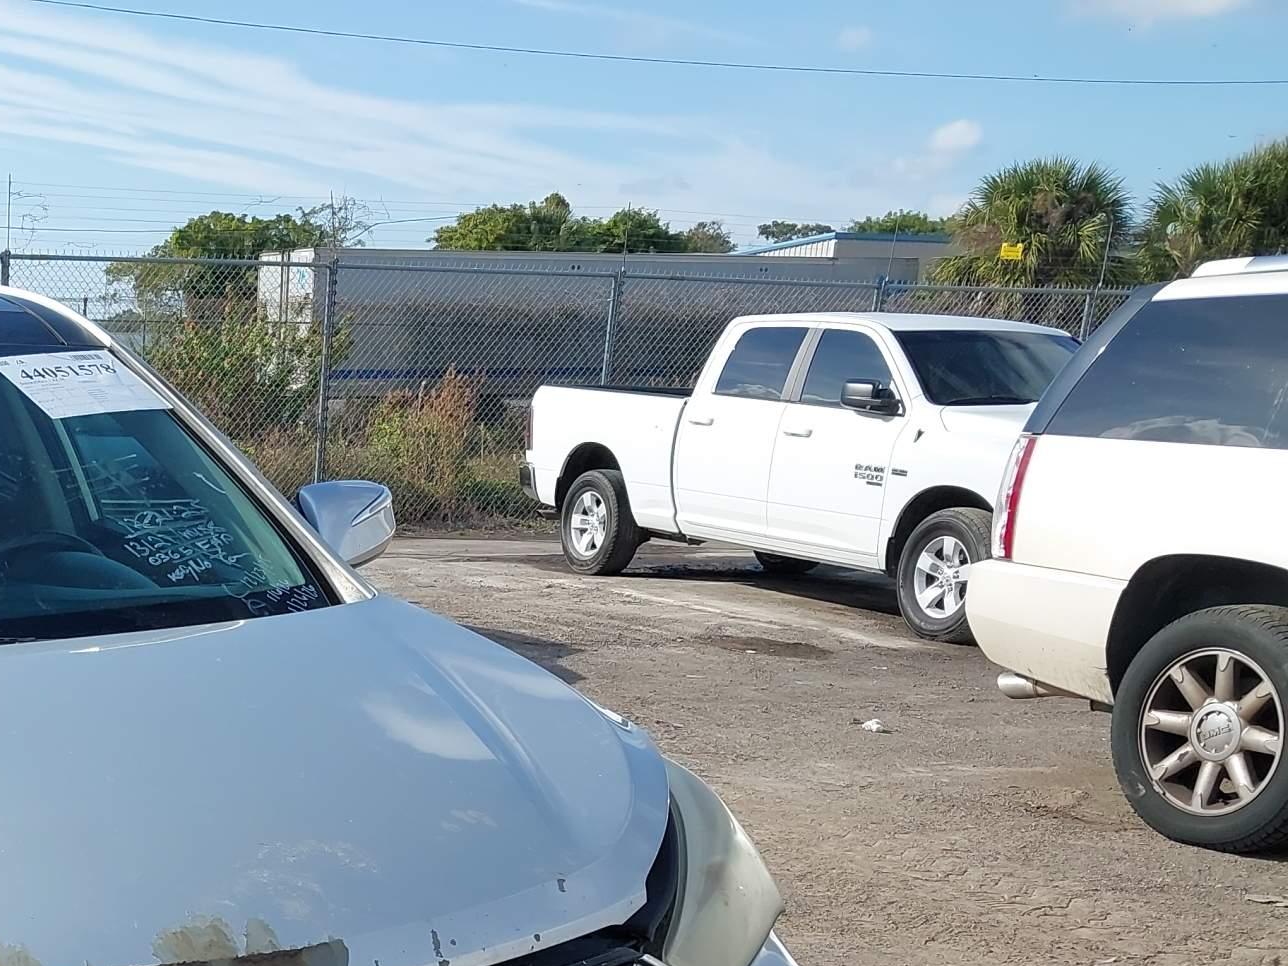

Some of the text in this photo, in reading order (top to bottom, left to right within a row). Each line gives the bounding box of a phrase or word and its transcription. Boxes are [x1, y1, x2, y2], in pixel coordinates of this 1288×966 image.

[20, 363, 117, 380] 44051578
[854, 464, 885, 474] RAM
[854, 472, 884, 482] 1500
